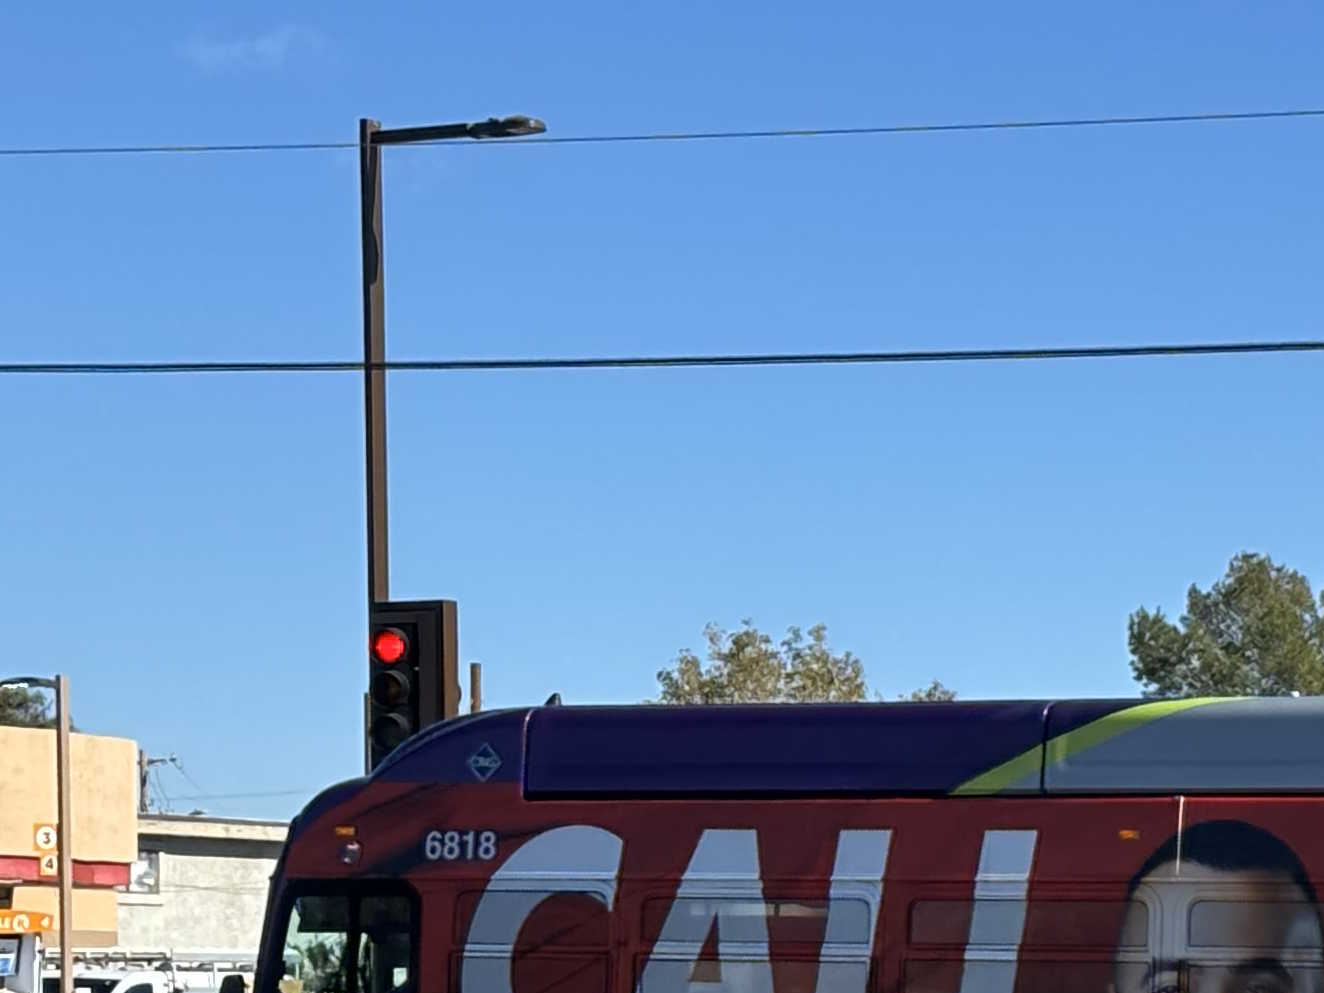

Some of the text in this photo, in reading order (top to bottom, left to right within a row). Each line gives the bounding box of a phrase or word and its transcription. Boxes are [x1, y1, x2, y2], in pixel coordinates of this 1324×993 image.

[42, 831, 52, 845] 3
[425, 830, 497, 860] 6818
[44, 857, 54, 870] 4
